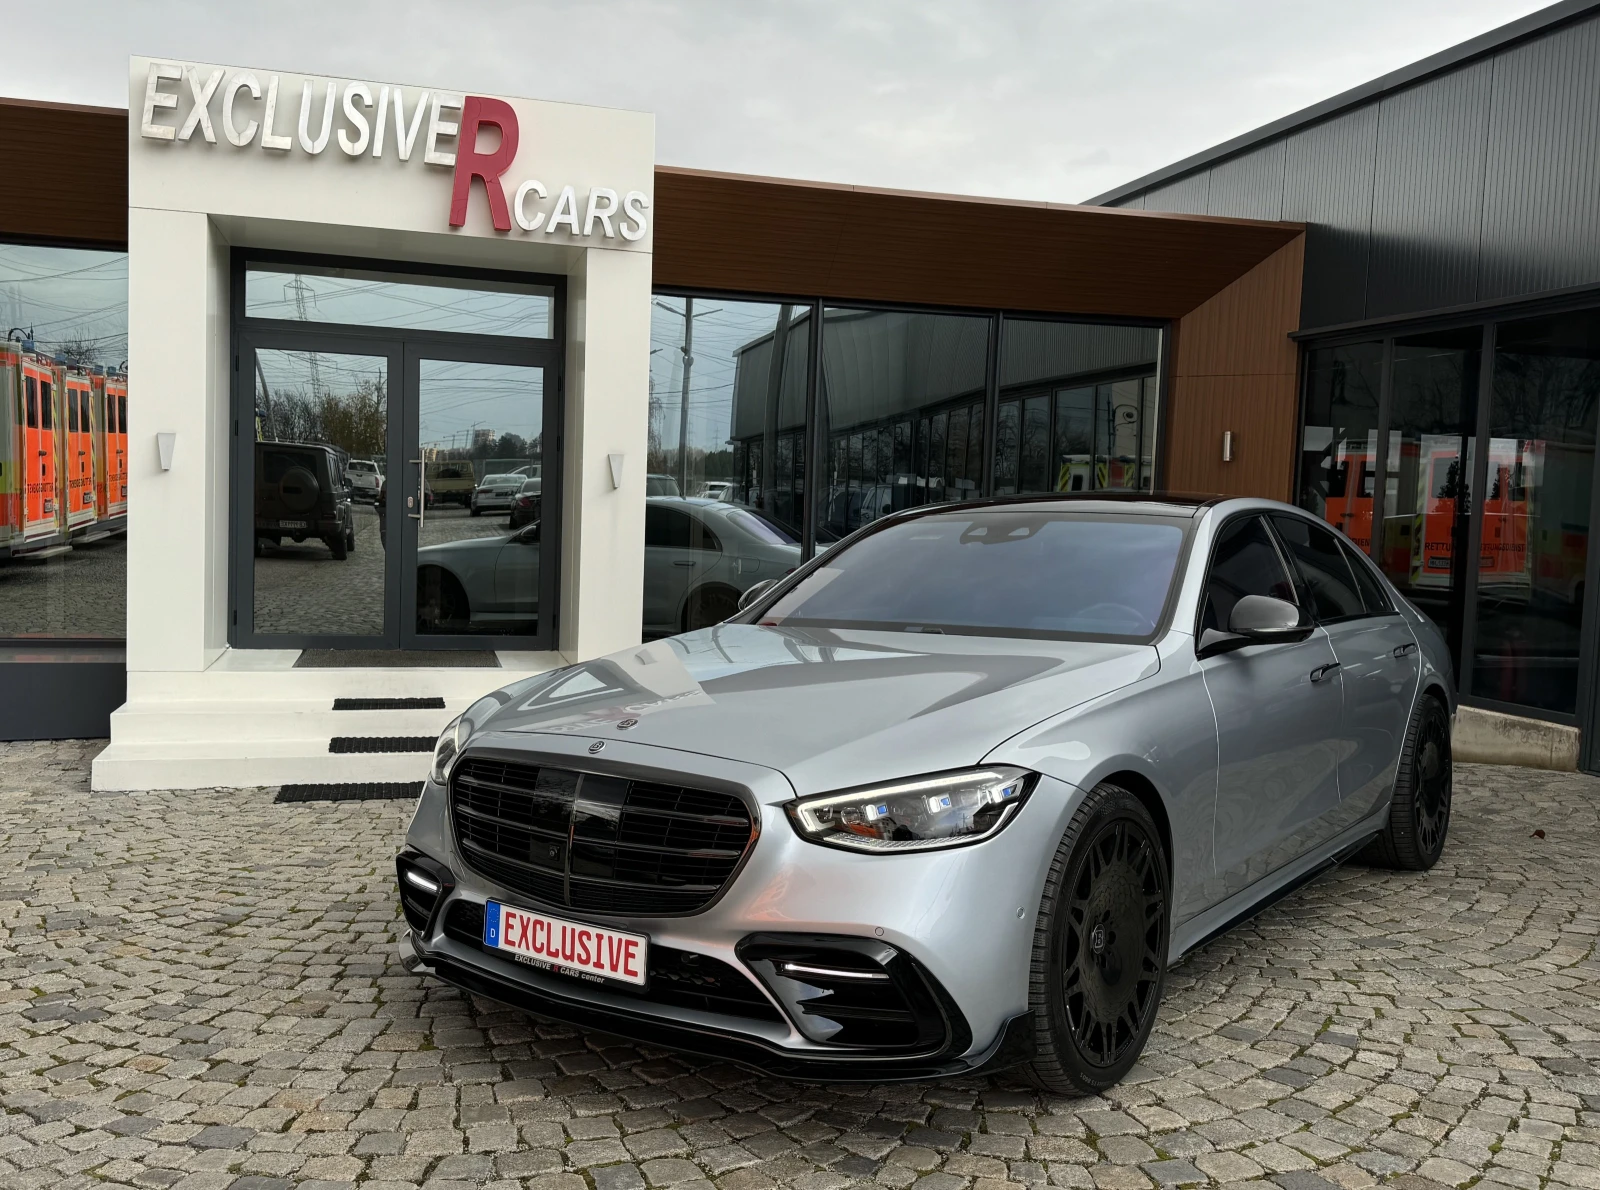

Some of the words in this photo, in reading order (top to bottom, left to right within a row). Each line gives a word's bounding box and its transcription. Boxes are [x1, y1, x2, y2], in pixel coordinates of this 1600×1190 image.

[141, 62, 463, 167] EXCLUSIVE
[449, 96, 519, 233] R
[514, 179, 649, 242] CARS
[490, 928, 496, 938] D
[504, 911, 639, 977] EXCLUSIVE
[560, 967, 580, 978] CARS
[581, 973, 605, 984] center
